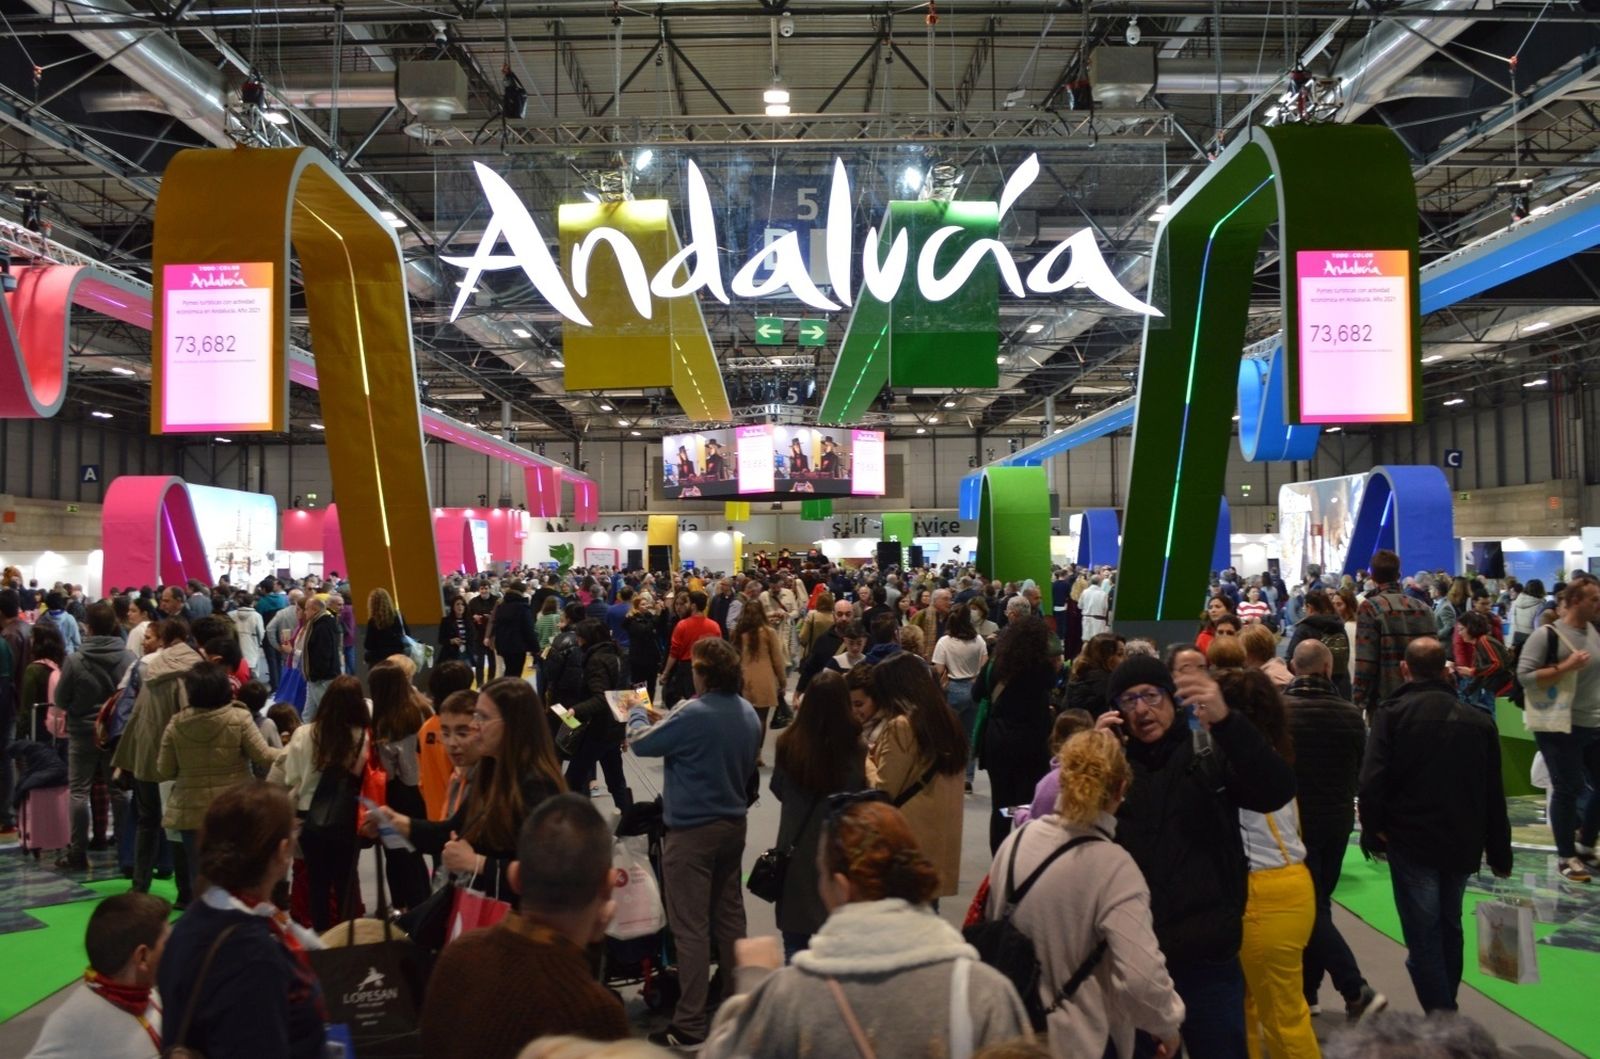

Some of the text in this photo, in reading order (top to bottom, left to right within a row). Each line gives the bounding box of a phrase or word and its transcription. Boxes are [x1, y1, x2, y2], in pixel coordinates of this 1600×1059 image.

[797, 187, 819, 221] 5
[440, 154, 1164, 326] Andalucía
[175, 335, 236, 356] 73,682
[1310, 324, 1372, 346] 73,682
[787, 387, 799, 404] 5
[1447, 452, 1460, 466] C
[84, 467, 97, 481] A
